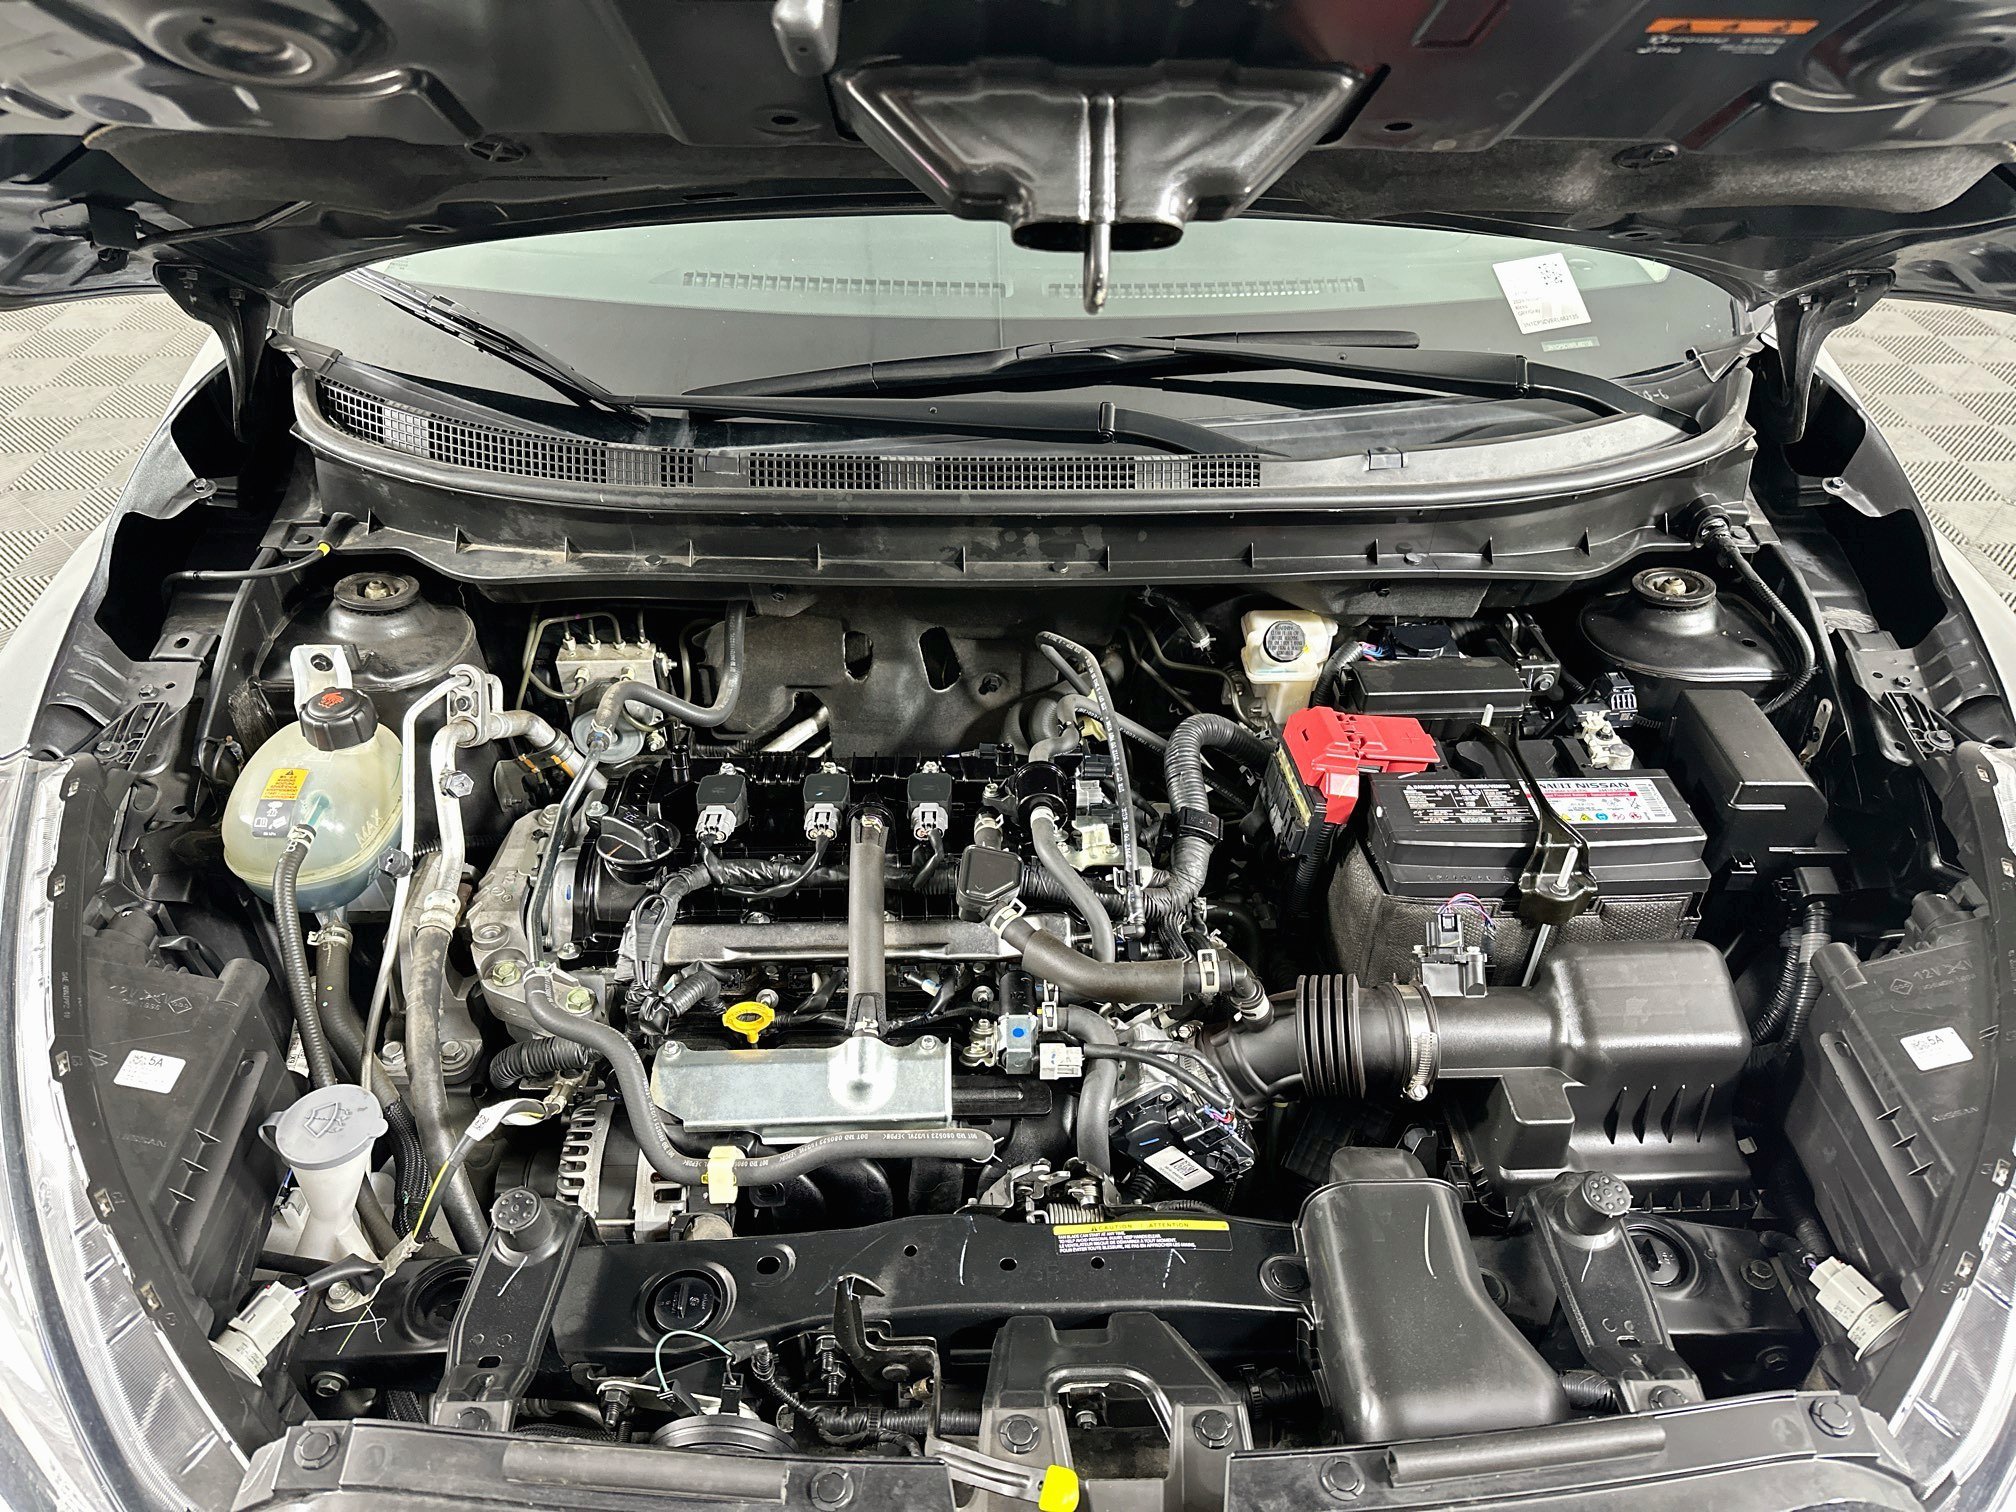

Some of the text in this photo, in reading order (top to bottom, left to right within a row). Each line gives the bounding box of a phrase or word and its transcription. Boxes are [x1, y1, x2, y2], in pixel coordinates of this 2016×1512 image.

[354, 808, 384, 850] MAX
[1926, 1034, 1944, 1046] 5A
[148, 1056, 163, 1068] 5A
